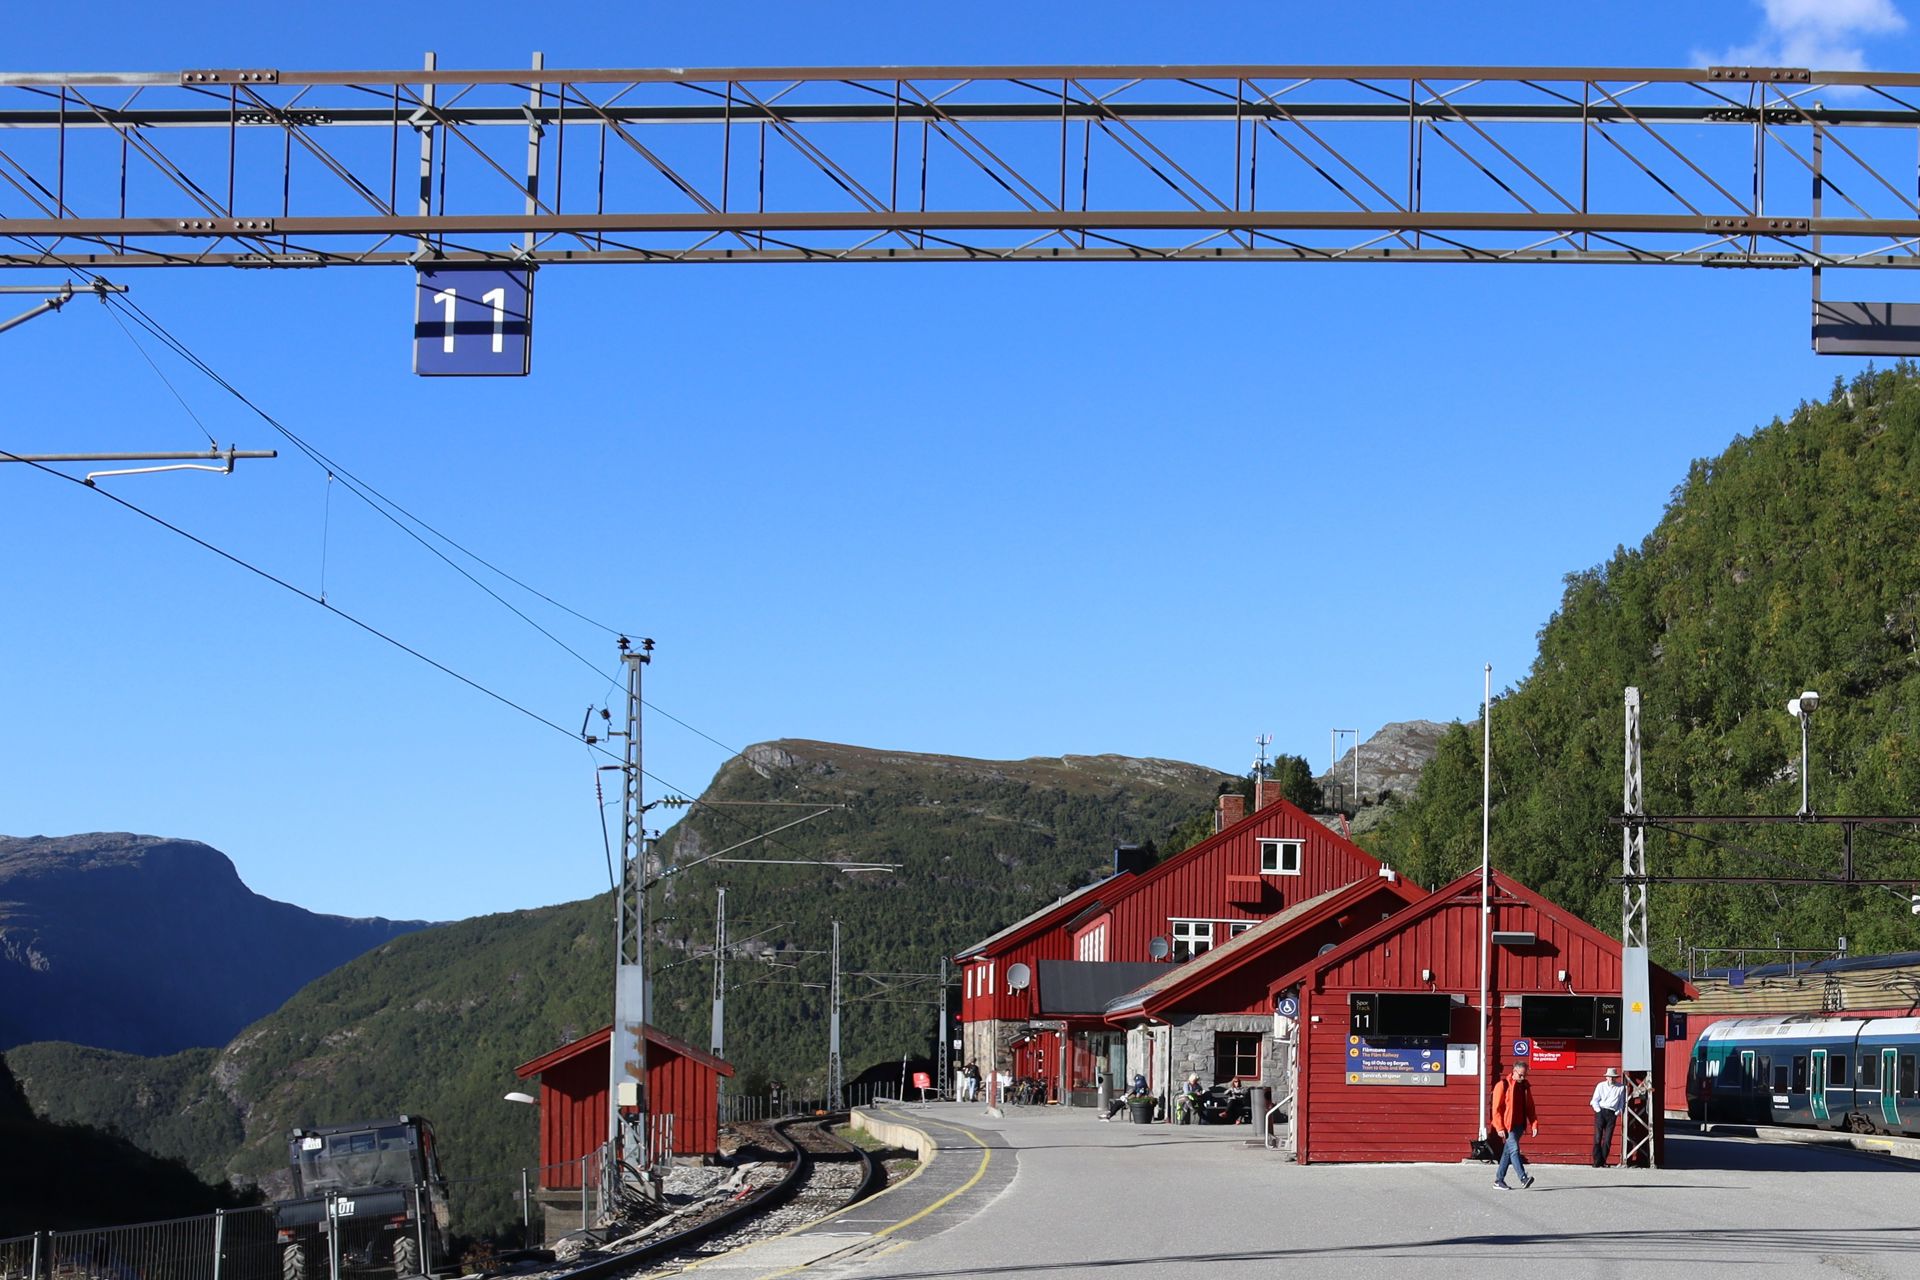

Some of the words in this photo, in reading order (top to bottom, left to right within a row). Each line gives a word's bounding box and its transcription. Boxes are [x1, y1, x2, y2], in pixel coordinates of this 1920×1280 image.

[433, 287, 505, 353] 11
[1354, 1014, 1369, 1028] 11
[1604, 1017, 1610, 1032] 1
[1674, 1024, 1680, 1036] 1
